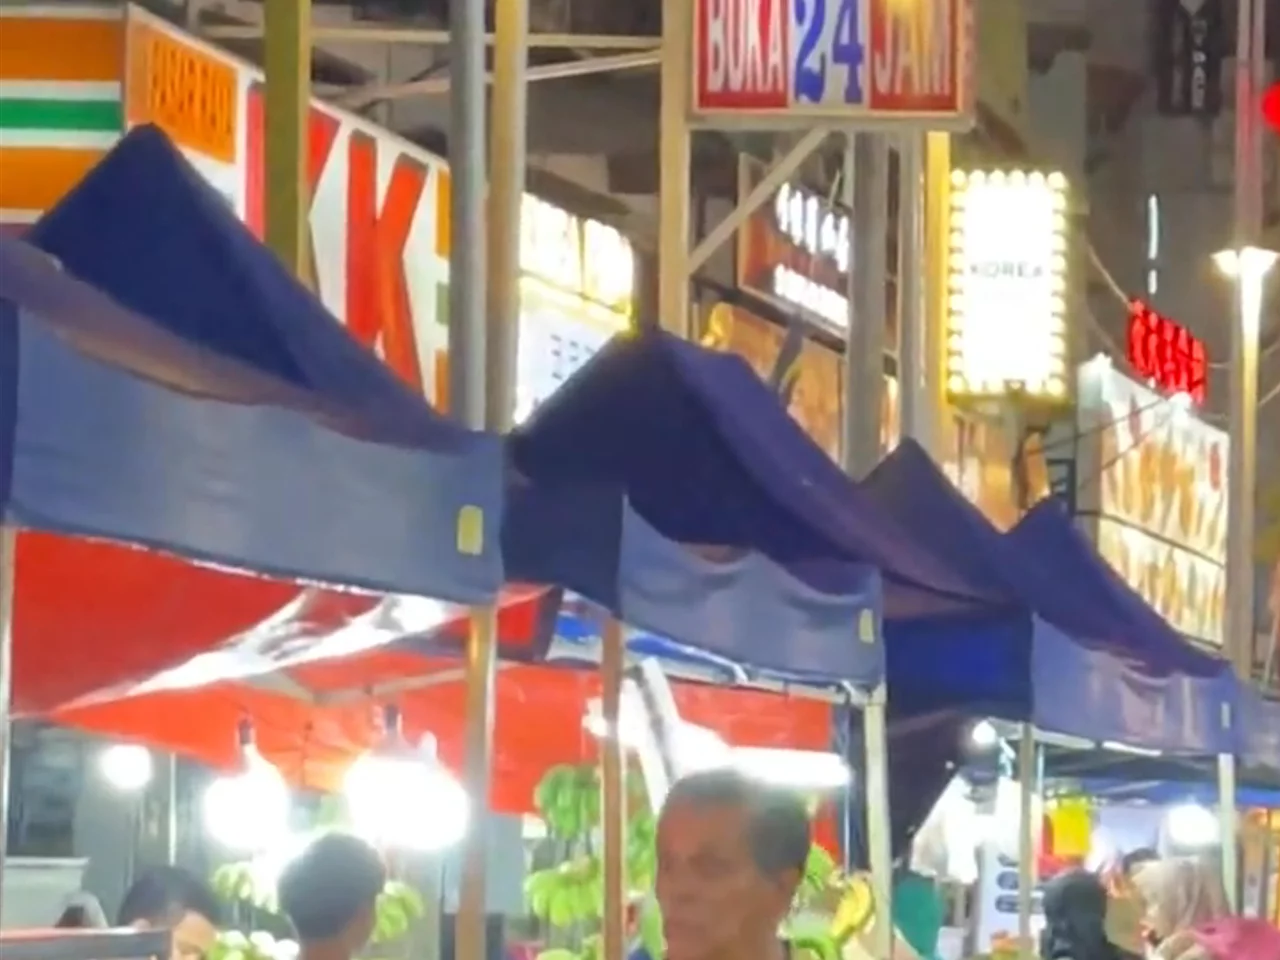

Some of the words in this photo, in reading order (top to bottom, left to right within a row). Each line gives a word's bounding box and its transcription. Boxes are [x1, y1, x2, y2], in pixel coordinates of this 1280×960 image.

[707, 0, 784, 92] BUKA
[795, 0, 863, 103] 24
[874, 0, 950, 95] JAM
